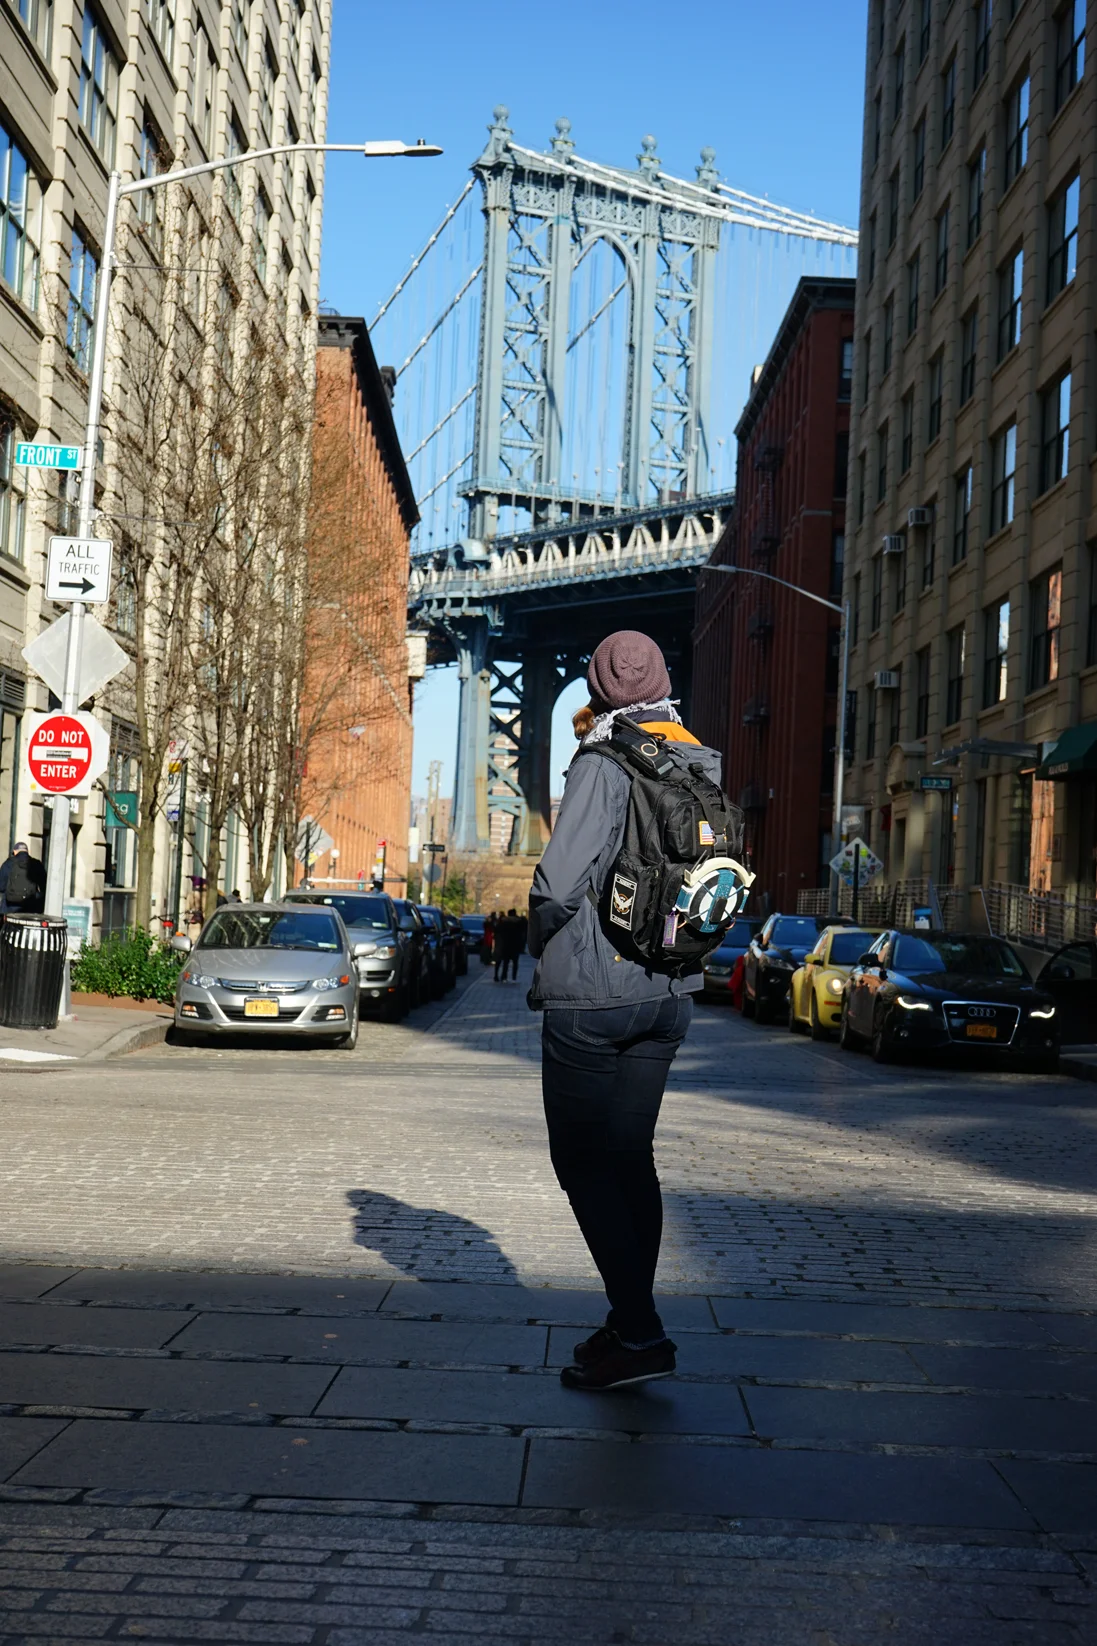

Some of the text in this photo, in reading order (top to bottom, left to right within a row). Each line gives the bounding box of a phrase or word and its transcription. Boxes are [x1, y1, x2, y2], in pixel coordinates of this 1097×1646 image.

[19, 445, 78, 466] FRONT ST
[65, 544, 95, 559] ALL
[59, 561, 100, 576] TRAFFIC
[38, 729, 84, 744] DO NOT
[40, 764, 77, 778] ENTER
